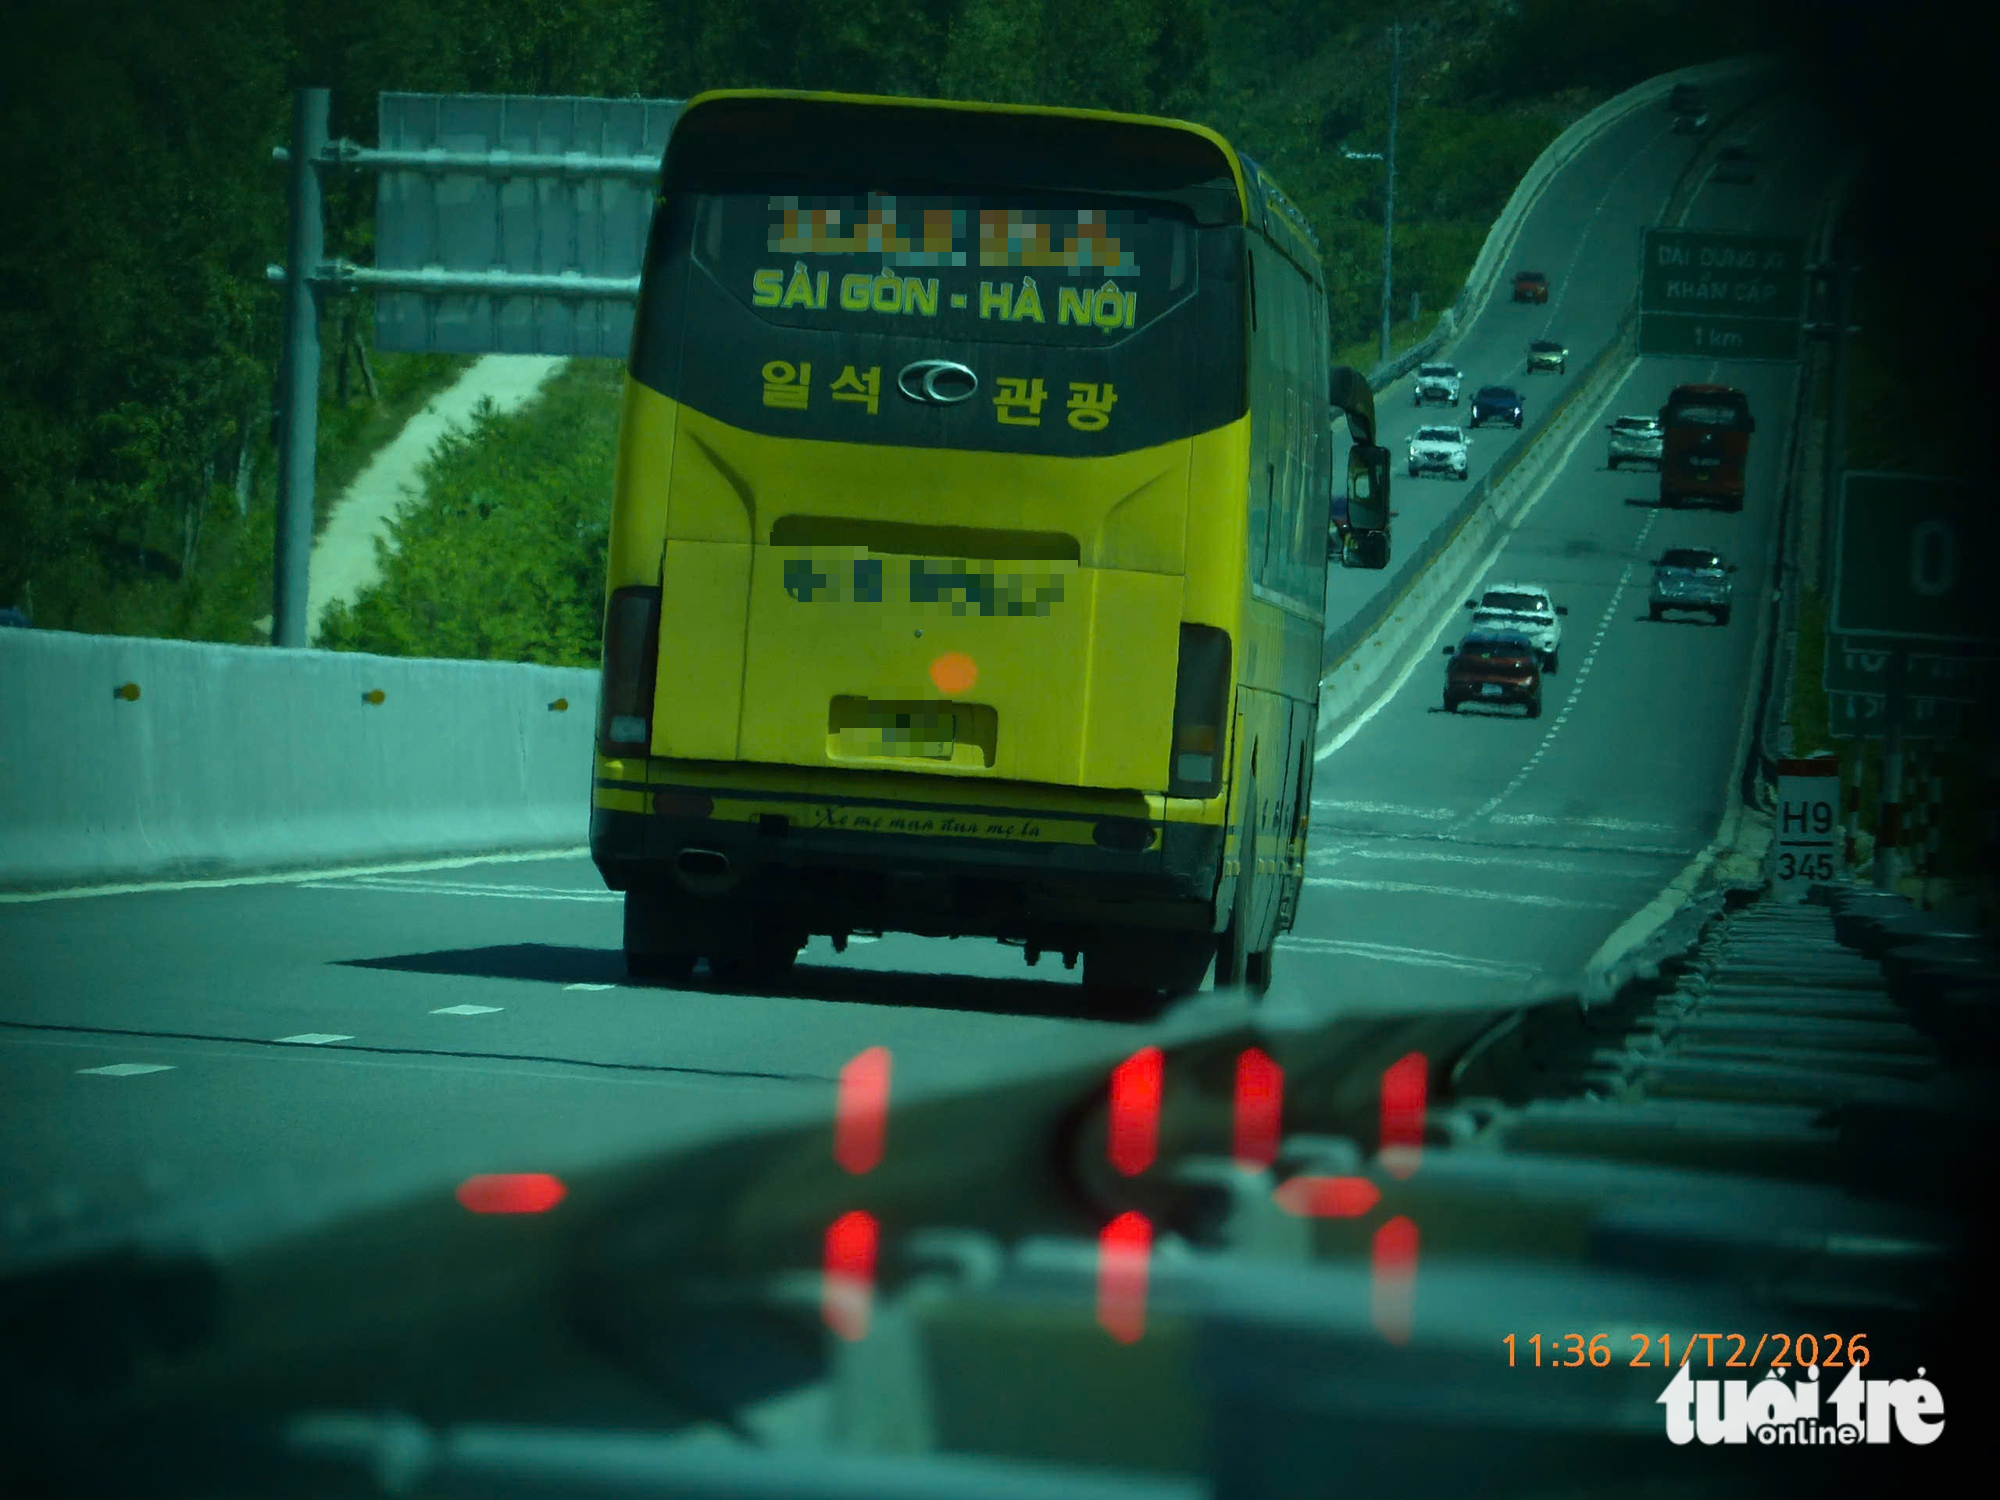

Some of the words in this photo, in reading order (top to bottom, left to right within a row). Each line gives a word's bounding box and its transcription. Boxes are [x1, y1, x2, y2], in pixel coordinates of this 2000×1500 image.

[752, 261, 829, 309] SÀI
[840, 266, 939, 317] GÒN
[950, 293, 967, 309] -
[979, 276, 1045, 324] HÀ
[1057, 279, 1137, 333] NỘI
[1694, 325, 1702, 346] 1
[1709, 326, 1743, 347] km
[813, 805, 848, 828] Xe
[1783, 801, 1832, 834] H9
[1778, 852, 1833, 881] 345
